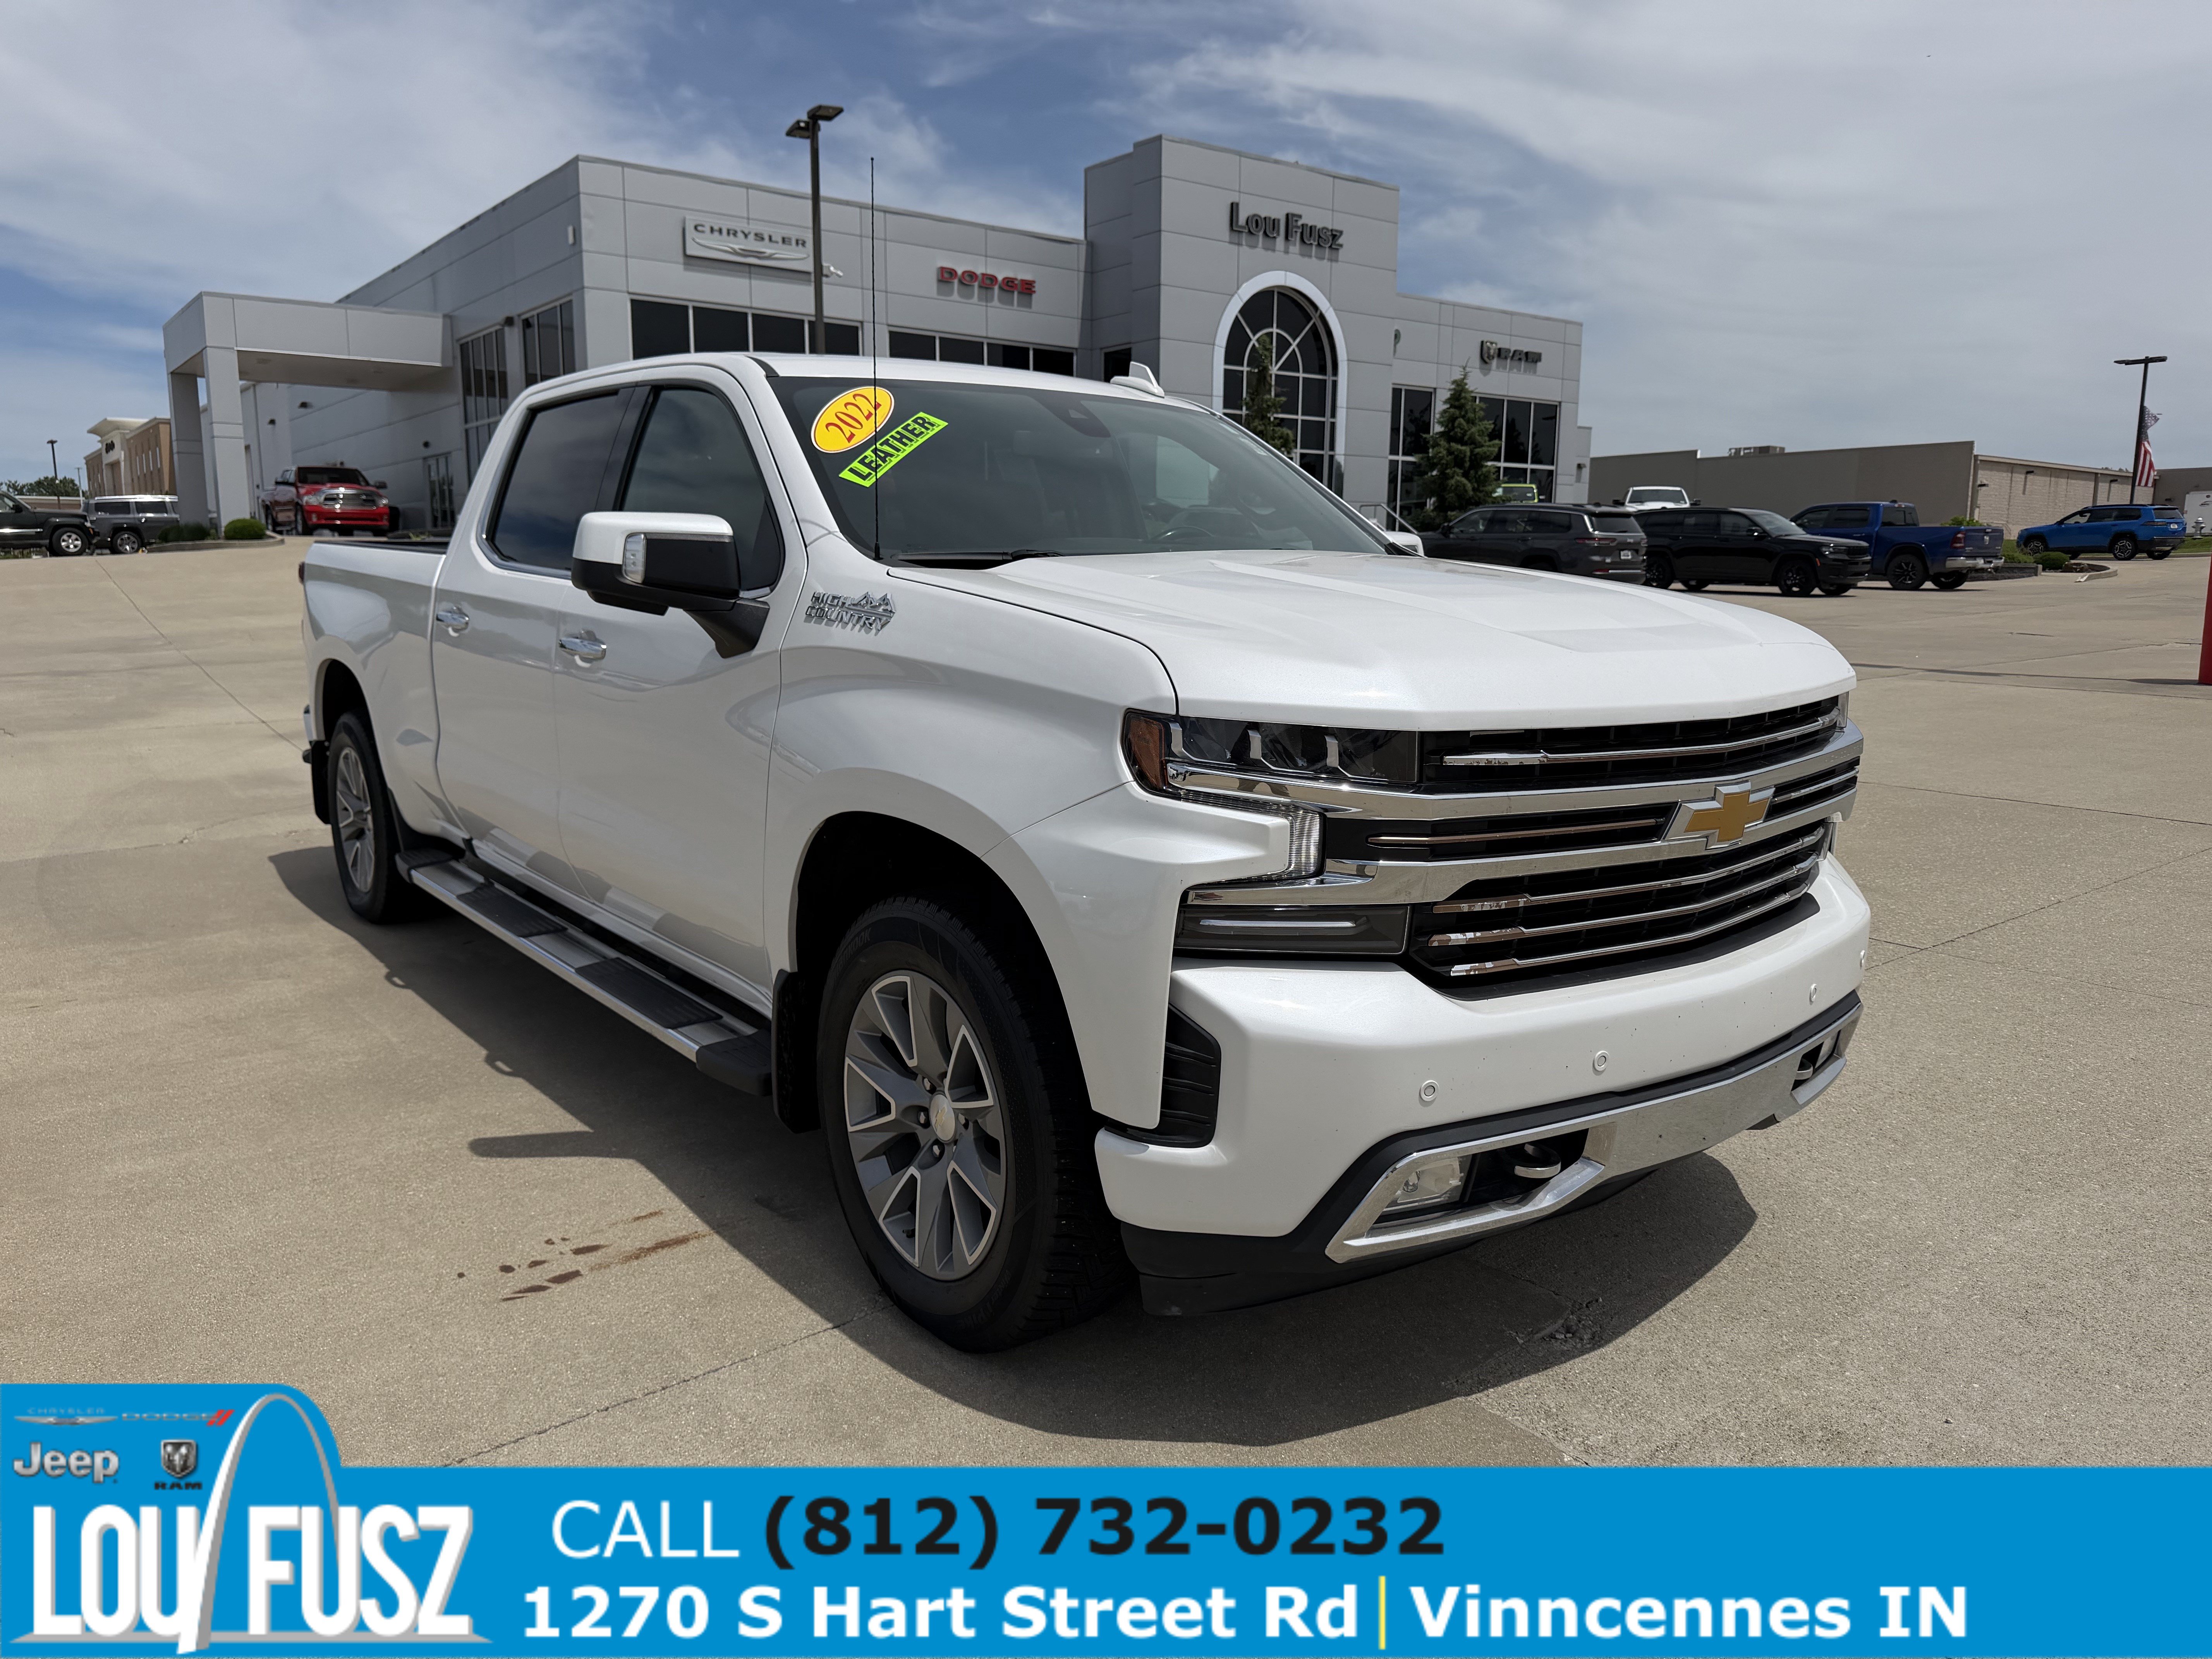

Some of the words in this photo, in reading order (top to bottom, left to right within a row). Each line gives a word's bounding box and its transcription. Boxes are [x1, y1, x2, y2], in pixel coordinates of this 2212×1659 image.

[694, 223, 807, 248] CHRYSLER
[1230, 202, 1281, 237] Lou
[1285, 212, 1344, 249] Fusz
[937, 266, 1036, 294] DODGE
[1497, 347, 1542, 362] RAM
[825, 393, 882, 443] 2022
[847, 416, 940, 481] LEATHER
[811, 591, 854, 608] HIGH
[805, 606, 890, 631] COUNTRY
